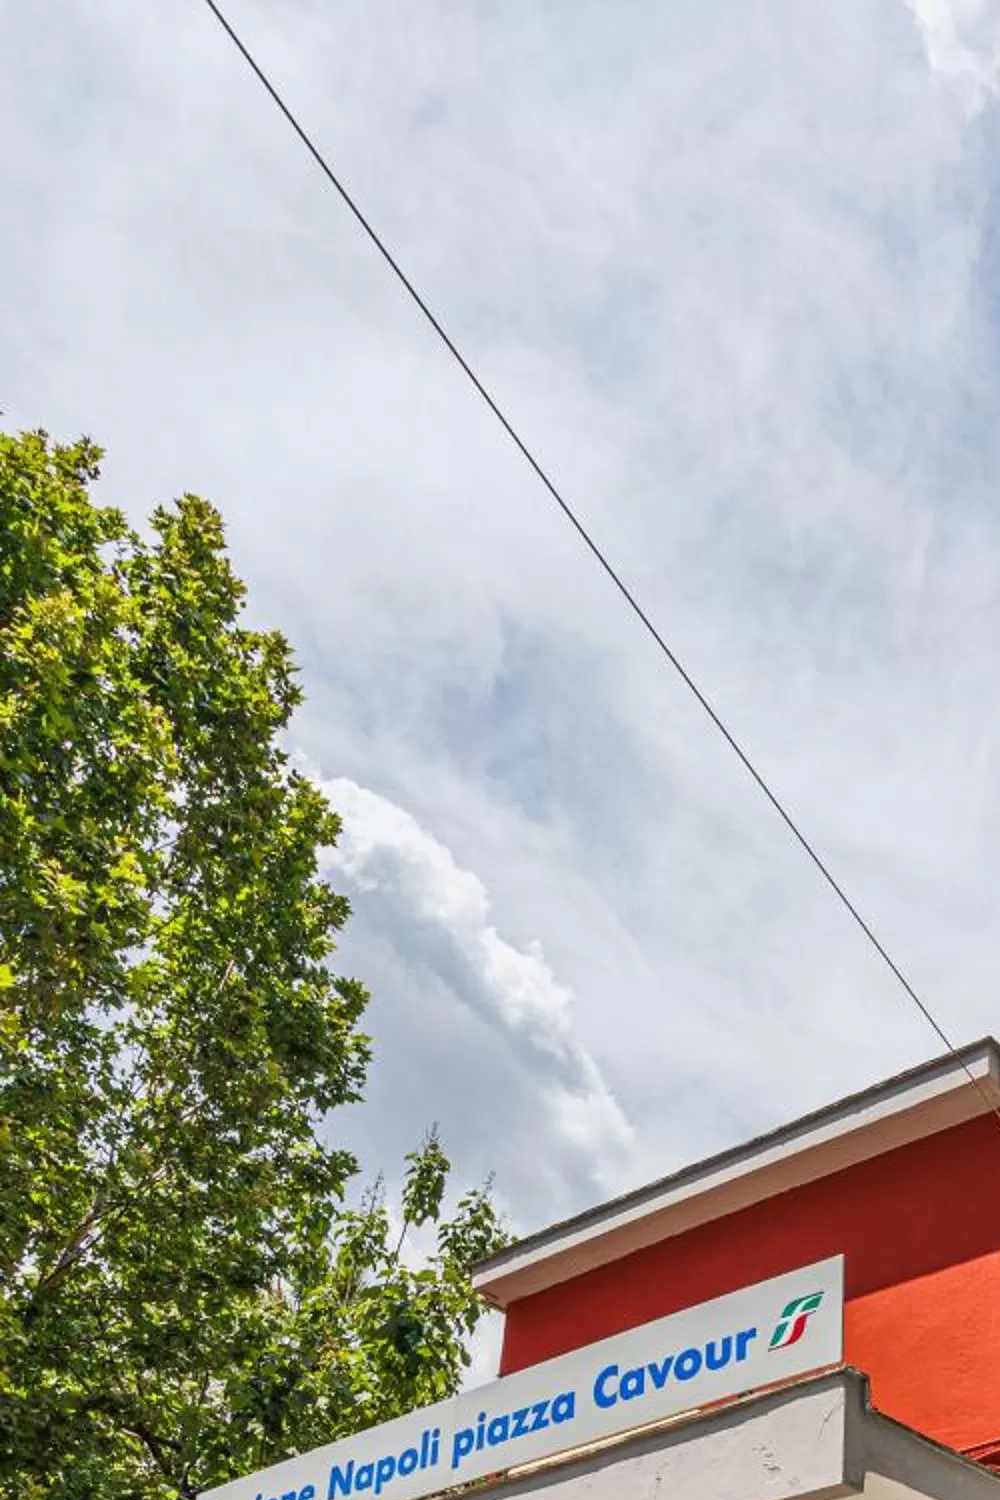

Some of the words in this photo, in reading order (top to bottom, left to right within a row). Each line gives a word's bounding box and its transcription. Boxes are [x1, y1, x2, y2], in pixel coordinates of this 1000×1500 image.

[328, 1431, 440, 1500] Napoli
[451, 1390, 576, 1468] piazza
[593, 1326, 757, 1408] Cavour
